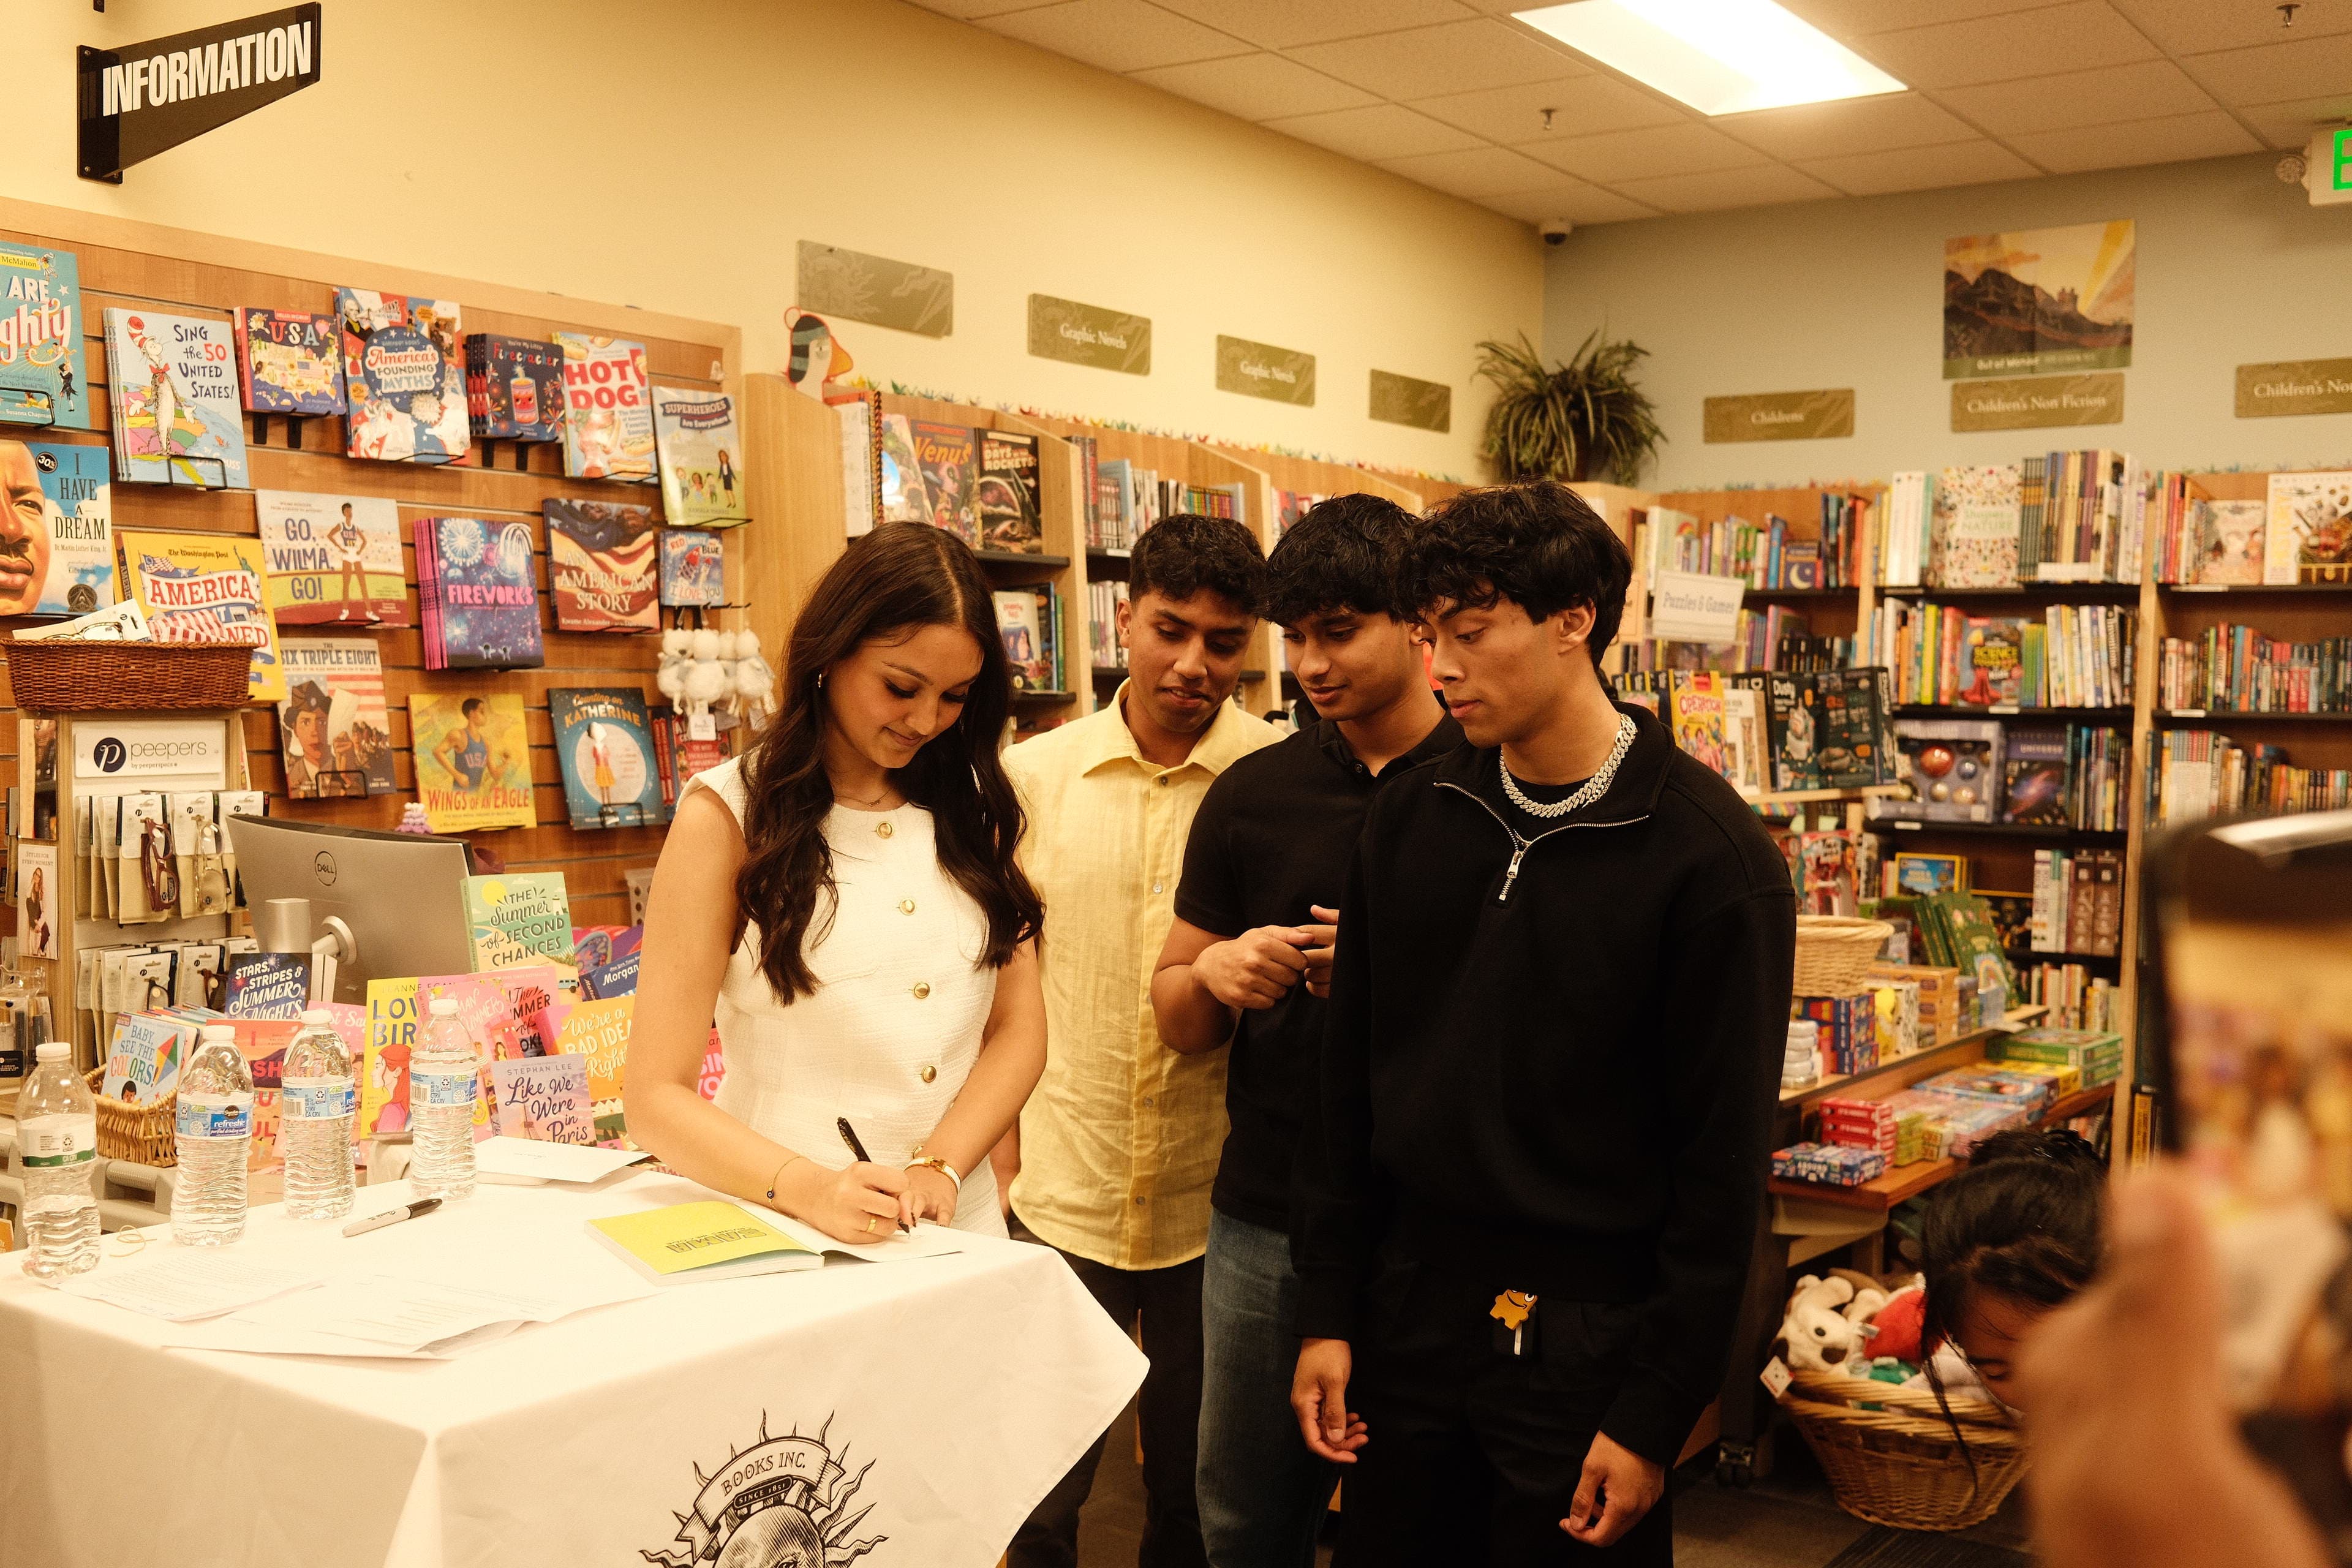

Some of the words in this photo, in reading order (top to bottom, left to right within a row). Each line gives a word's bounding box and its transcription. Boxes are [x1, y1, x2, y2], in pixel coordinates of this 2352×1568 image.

[103, 21, 312, 117] INFORMATION
[1, 255, 37, 268] McMahon
[7, 275, 50, 303] ARE
[173, 323, 208, 343] SING
[1059, 322, 1097, 345] Graphic
[1098, 331, 1127, 350] Novels
[184, 345, 202, 360] the
[205, 343, 227, 361] 50
[368, 345, 438, 368] America's
[493, 342, 559, 368] Firecracker
[178, 363, 222, 379] UNITED
[377, 364, 435, 377] FOUNDING
[564, 360, 631, 386] HOT
[191, 381, 235, 399] STATES!
[382, 374, 435, 393] MYTHS
[2253, 379, 2323, 399] Children's
[570, 385, 639, 410] DOG
[665, 401, 726, 414] SUPERHEROES
[1966, 398, 2028, 414] Children's
[2030, 396, 2059, 410] Non
[2062, 394, 2107, 409] Fiction
[913, 435, 973, 466] Venus
[984, 446, 1012, 461] DAYS
[75, 453, 80, 475] I
[59, 478, 97, 500] HAVE
[75, 504, 83, 515] A
[55, 516, 106, 540] DREAM
[285, 518, 317, 543] GO,
[168, 548, 180, 557] The
[181, 549, 215, 559] Washington
[216, 550, 229, 559] Post
[670, 538, 685, 549] RED
[701, 545, 720, 555] BLUE
[272, 548, 335, 571] WILMA,
[565, 552, 589, 567] AN
[150, 575, 256, 606] AMERICA
[291, 577, 323, 600] GO!
[560, 570, 655, 592] AMERICAN
[447, 584, 534, 606] FIREWORKS
[576, 592, 633, 613] STORY
[679, 586, 702, 600] LOVE
[704, 586, 720, 599] YOU
[1662, 592, 1697, 611] Puzzles
[1705, 595, 1735, 614] Games
[282, 649, 299, 665] SIX
[300, 650, 344, 665] TRIPLE
[345, 650, 377, 665] EIGHT
[572, 693, 611, 707] Counting
[611, 696, 624, 705] on
[564, 704, 642, 729] KATHERINE
[130, 739, 207, 761] peepers
[428, 789, 469, 812] WINGS
[470, 797, 479, 810] OF
[481, 796, 491, 809] AN
[493, 786, 530, 809] EAGLE
[317, 863, 335, 874] DELL
[510, 889, 531, 904] THE
[490, 899, 552, 928] Summer
[481, 932, 504, 950] of
[506, 918, 565, 944] SECOND
[491, 937, 562, 967] CHANCES
[235, 960, 271, 980] STARS,
[249, 968, 293, 990] STRIPES
[602, 964, 639, 986] Morgan
[229, 981, 302, 1015] SUMMER
[243, 999, 303, 1019] NIGHTS
[562, 1011, 612, 1036] We're
[616, 1008, 627, 1019] a
[130, 1023, 155, 1046] BABY,
[120, 1039, 138, 1054] SEE
[138, 1044, 155, 1062] THE
[110, 1055, 159, 1088] COLORS!
[507, 1065, 551, 1076] STEPHAN
[556, 1063, 572, 1072] LEE
[505, 1076, 545, 1107] Like
[549, 1076, 574, 1093] We
[531, 1096, 577, 1121] Were
[565, 1114, 578, 1128] in
[546, 1121, 589, 1144] Paris
[720, 1455, 774, 1497] BOOKS
[778, 1452, 806, 1470] INC.
[738, 1488, 764, 1505] SINCE
[767, 1483, 786, 1496] 1851
